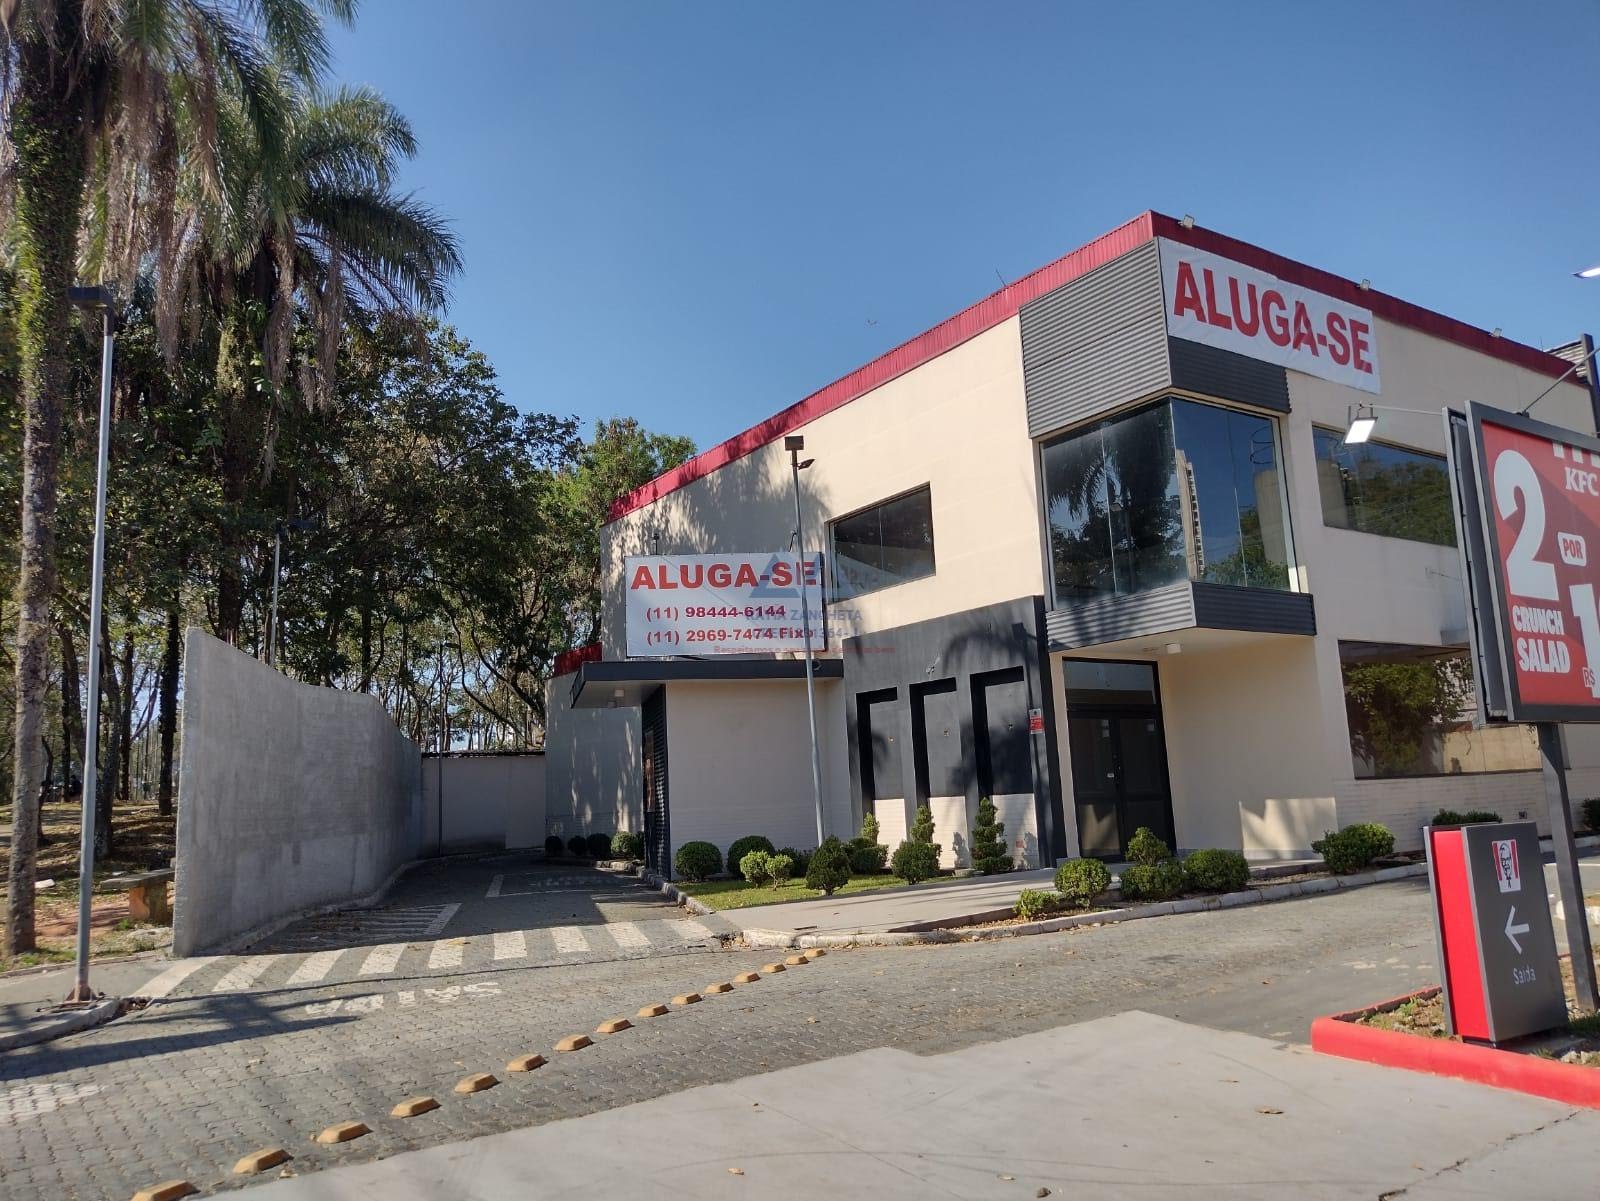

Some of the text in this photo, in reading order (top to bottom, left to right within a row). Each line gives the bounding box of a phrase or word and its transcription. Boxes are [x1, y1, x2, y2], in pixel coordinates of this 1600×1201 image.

[1173, 261, 1373, 374] ALUGA-SE
[1564, 466, 1599, 496] KFC
[1493, 449, 1560, 601] 2
[1562, 537, 1584, 560] POR
[630, 561, 816, 590] ALUGA-SE
[646, 605, 786, 623] (11) 98444-6144
[1512, 605, 1564, 635] CRUNCH
[647, 630, 680, 646] (11)
[686, 627, 774, 642] 2969-7474
[1516, 637, 1570, 674] SALAD
